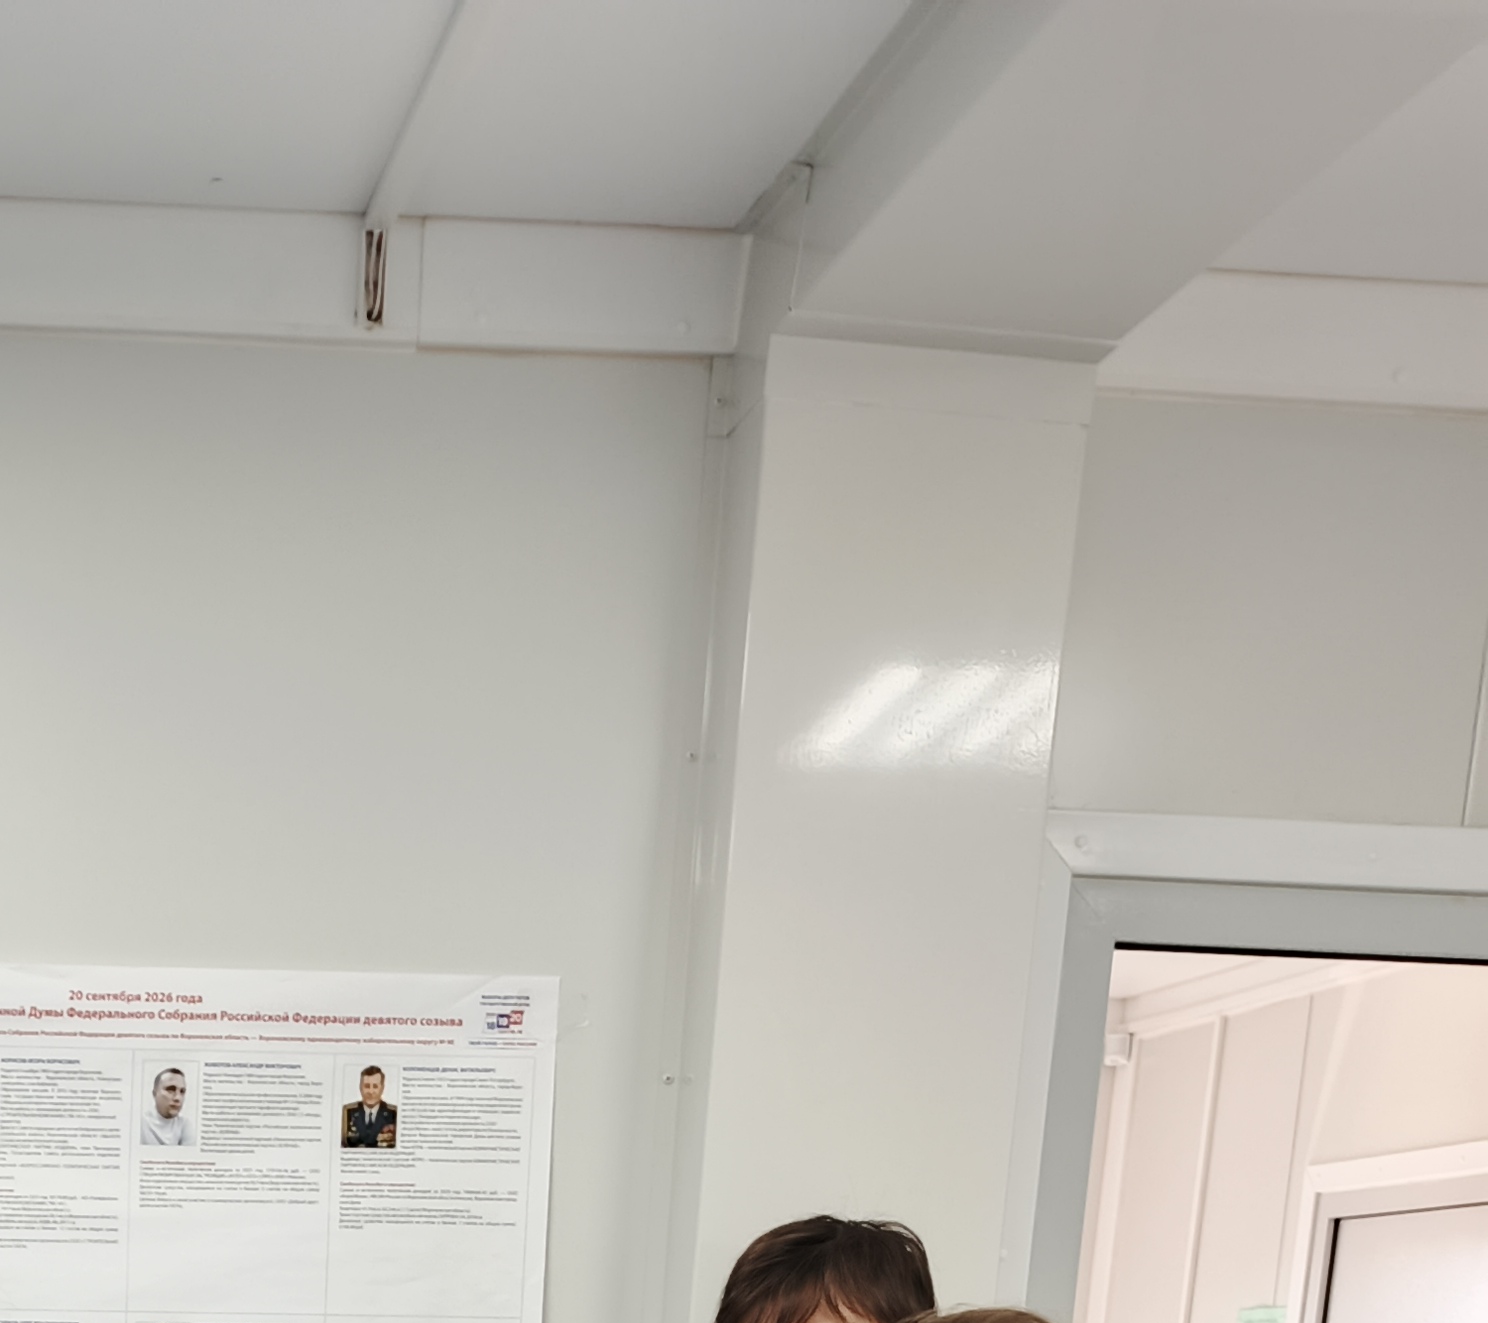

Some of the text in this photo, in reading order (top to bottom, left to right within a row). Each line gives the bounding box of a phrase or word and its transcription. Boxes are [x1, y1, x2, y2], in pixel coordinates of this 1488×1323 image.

[69, 991, 203, 1008] 20 сентября 2026 года
[28, 1006, 65, 1020] Думы
[67, 1008, 156, 1022] Федерального
[158, 1009, 218, 1023] Собрания
[220, 1010, 290, 1023] Российской
[292, 1012, 361, 1026] Федерации
[363, 1016, 418, 1028] девятого
[420, 1018, 463, 1028] созыва
